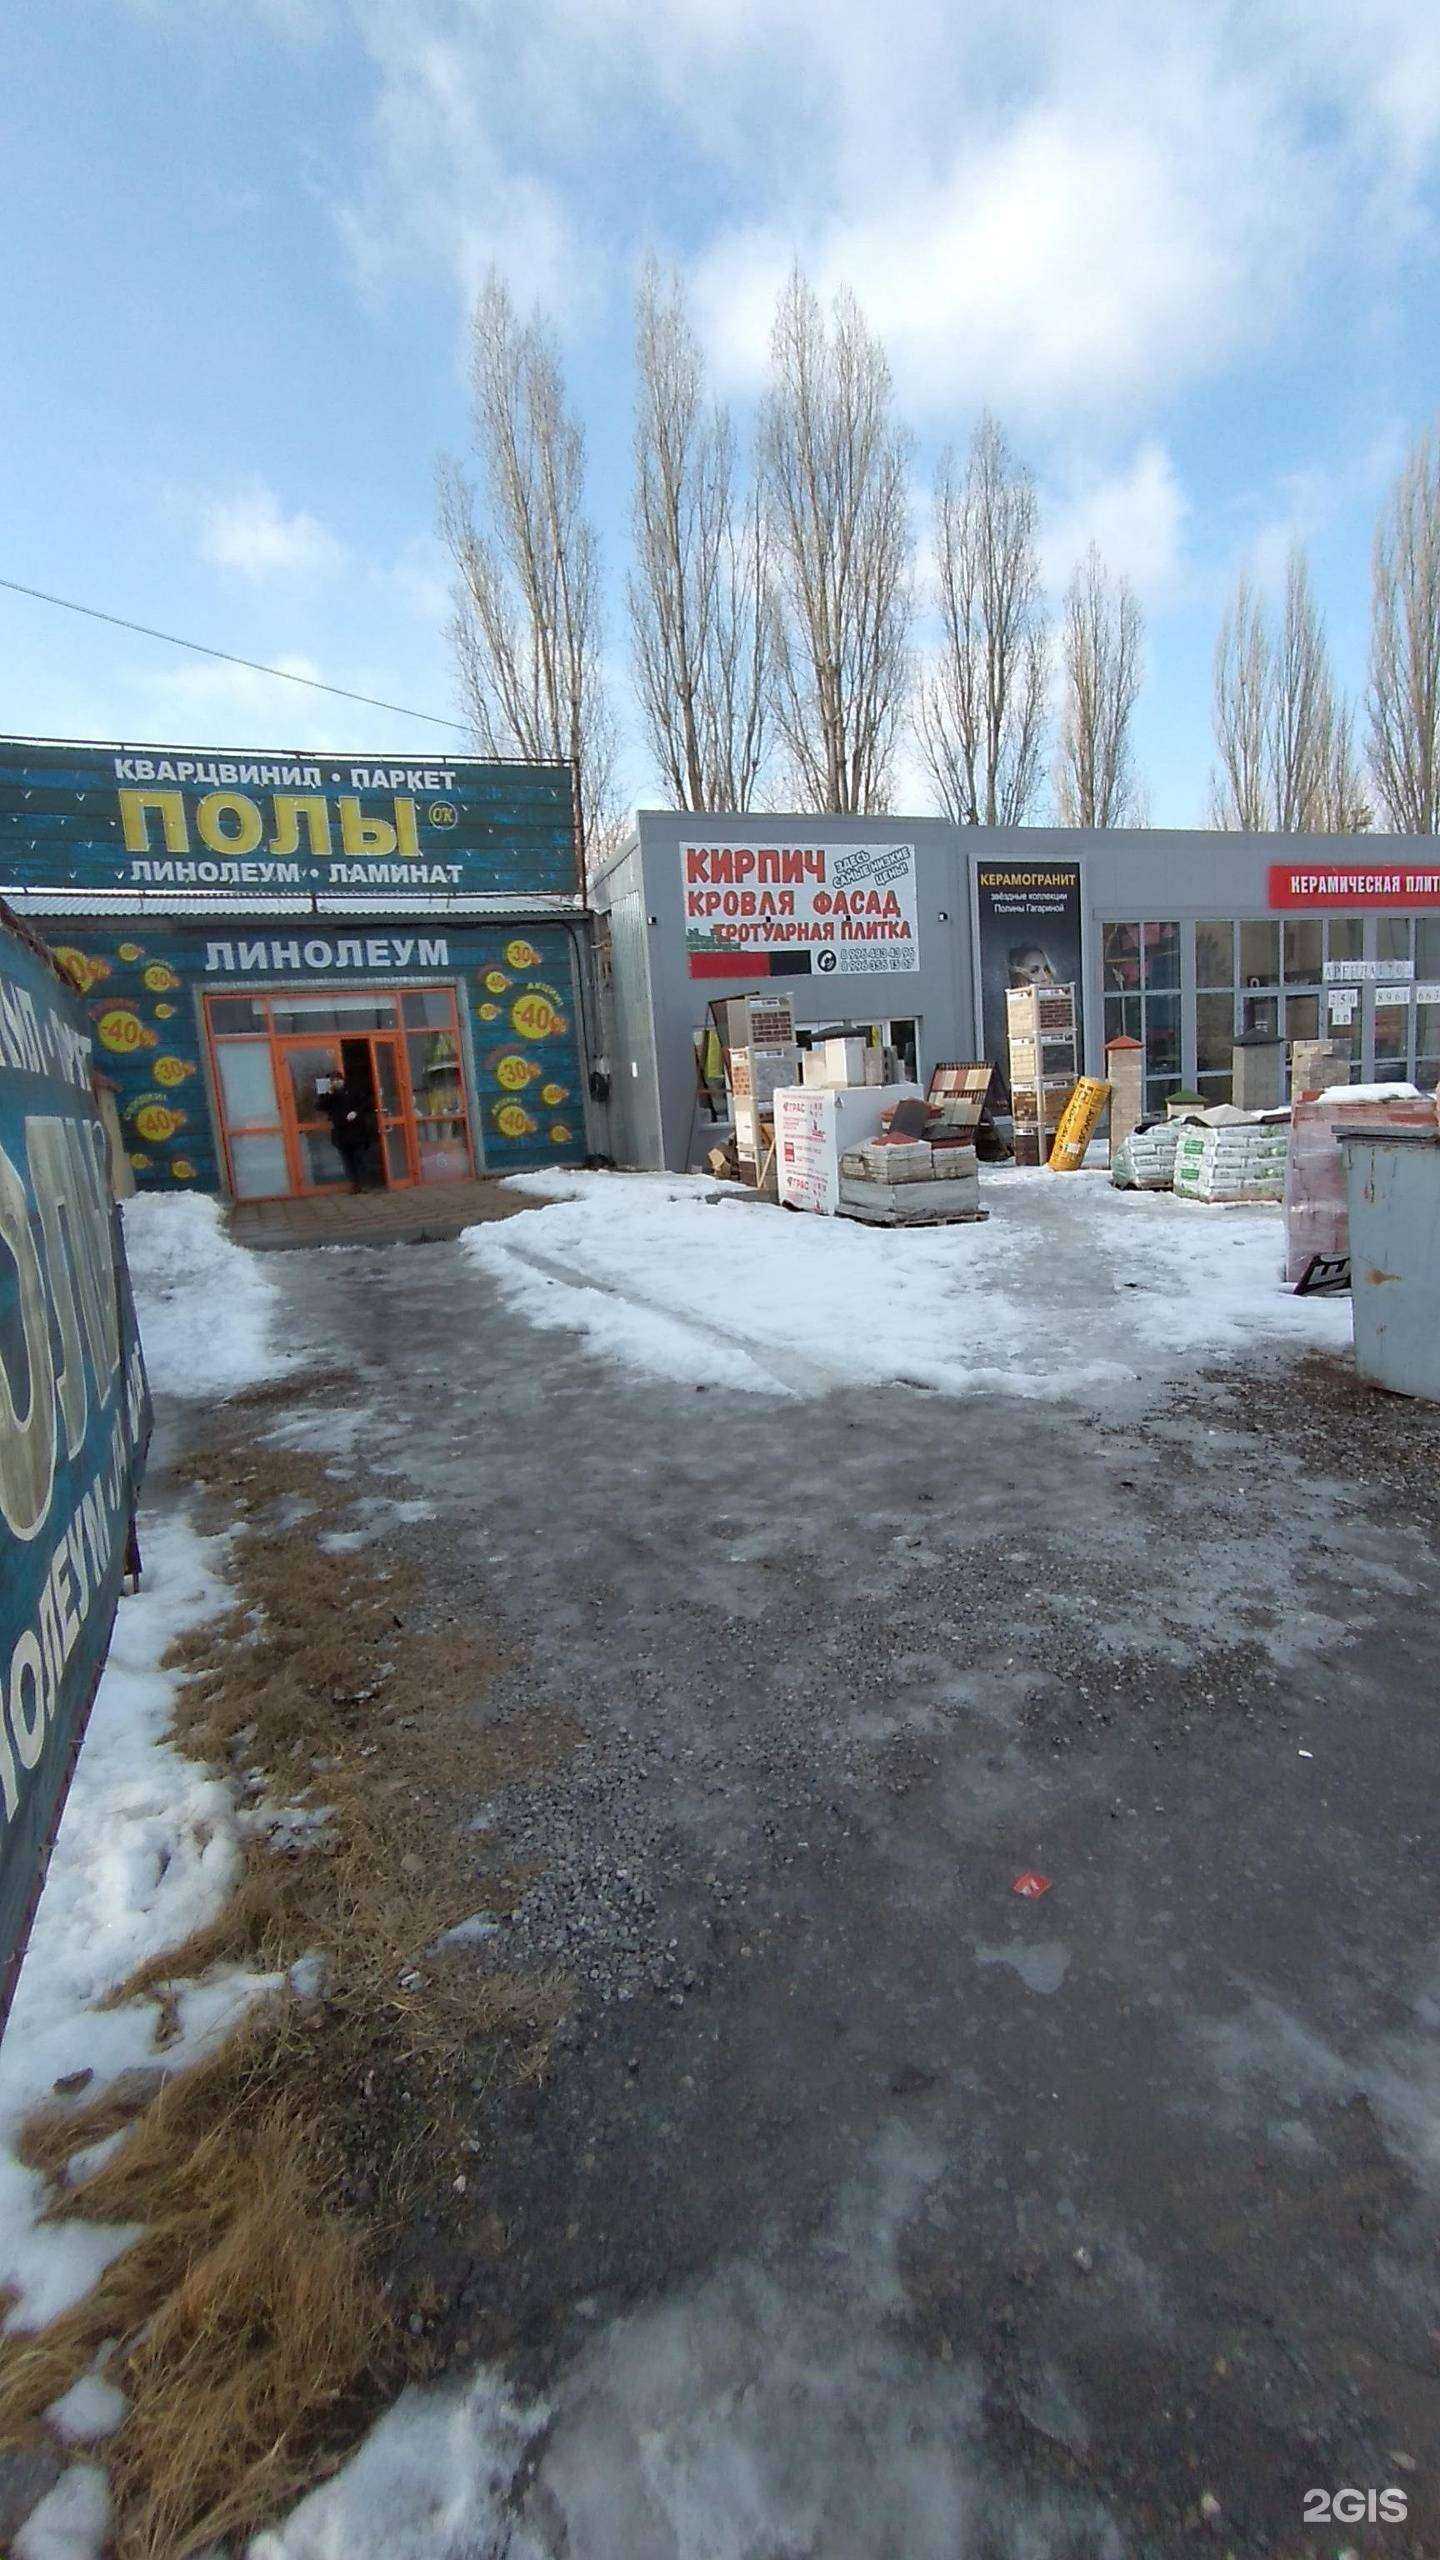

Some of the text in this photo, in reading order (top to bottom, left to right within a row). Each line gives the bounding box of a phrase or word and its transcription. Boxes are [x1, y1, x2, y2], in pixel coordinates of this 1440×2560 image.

[115, 758, 457, 790] КВАРЦВИНИЛ ПАРКЕТ
[118, 788, 422, 857] ПОЛЫ
[130, 860, 464, 884] ЛИНОЛЕУМ ЛАМИНАТ
[686, 848, 827, 884] КИРПИЧ
[832, 846, 912, 890] САМЫЕ НИЗКИЕ
[834, 850, 870, 872] ЗДЕСЬ
[874, 861, 909, 887] ЦЕНЫ!
[980, 873, 1076, 887] КЕРАМОГРАНИТ
[1290, 875, 1440, 893] КЕРАМИЧЕСКАЯ ПЛИТ
[688, 890, 903, 919] КРОВЛЯ ФАСАД
[991, 891, 1068, 902] звёздные коллекции
[994, 903, 1065, 915] Полины Гагариной
[712, 920, 913, 944] ТРОТУАРНАЯ ПЛИТКА
[205, 939, 450, 971] ЛИНОЛЕУМ
